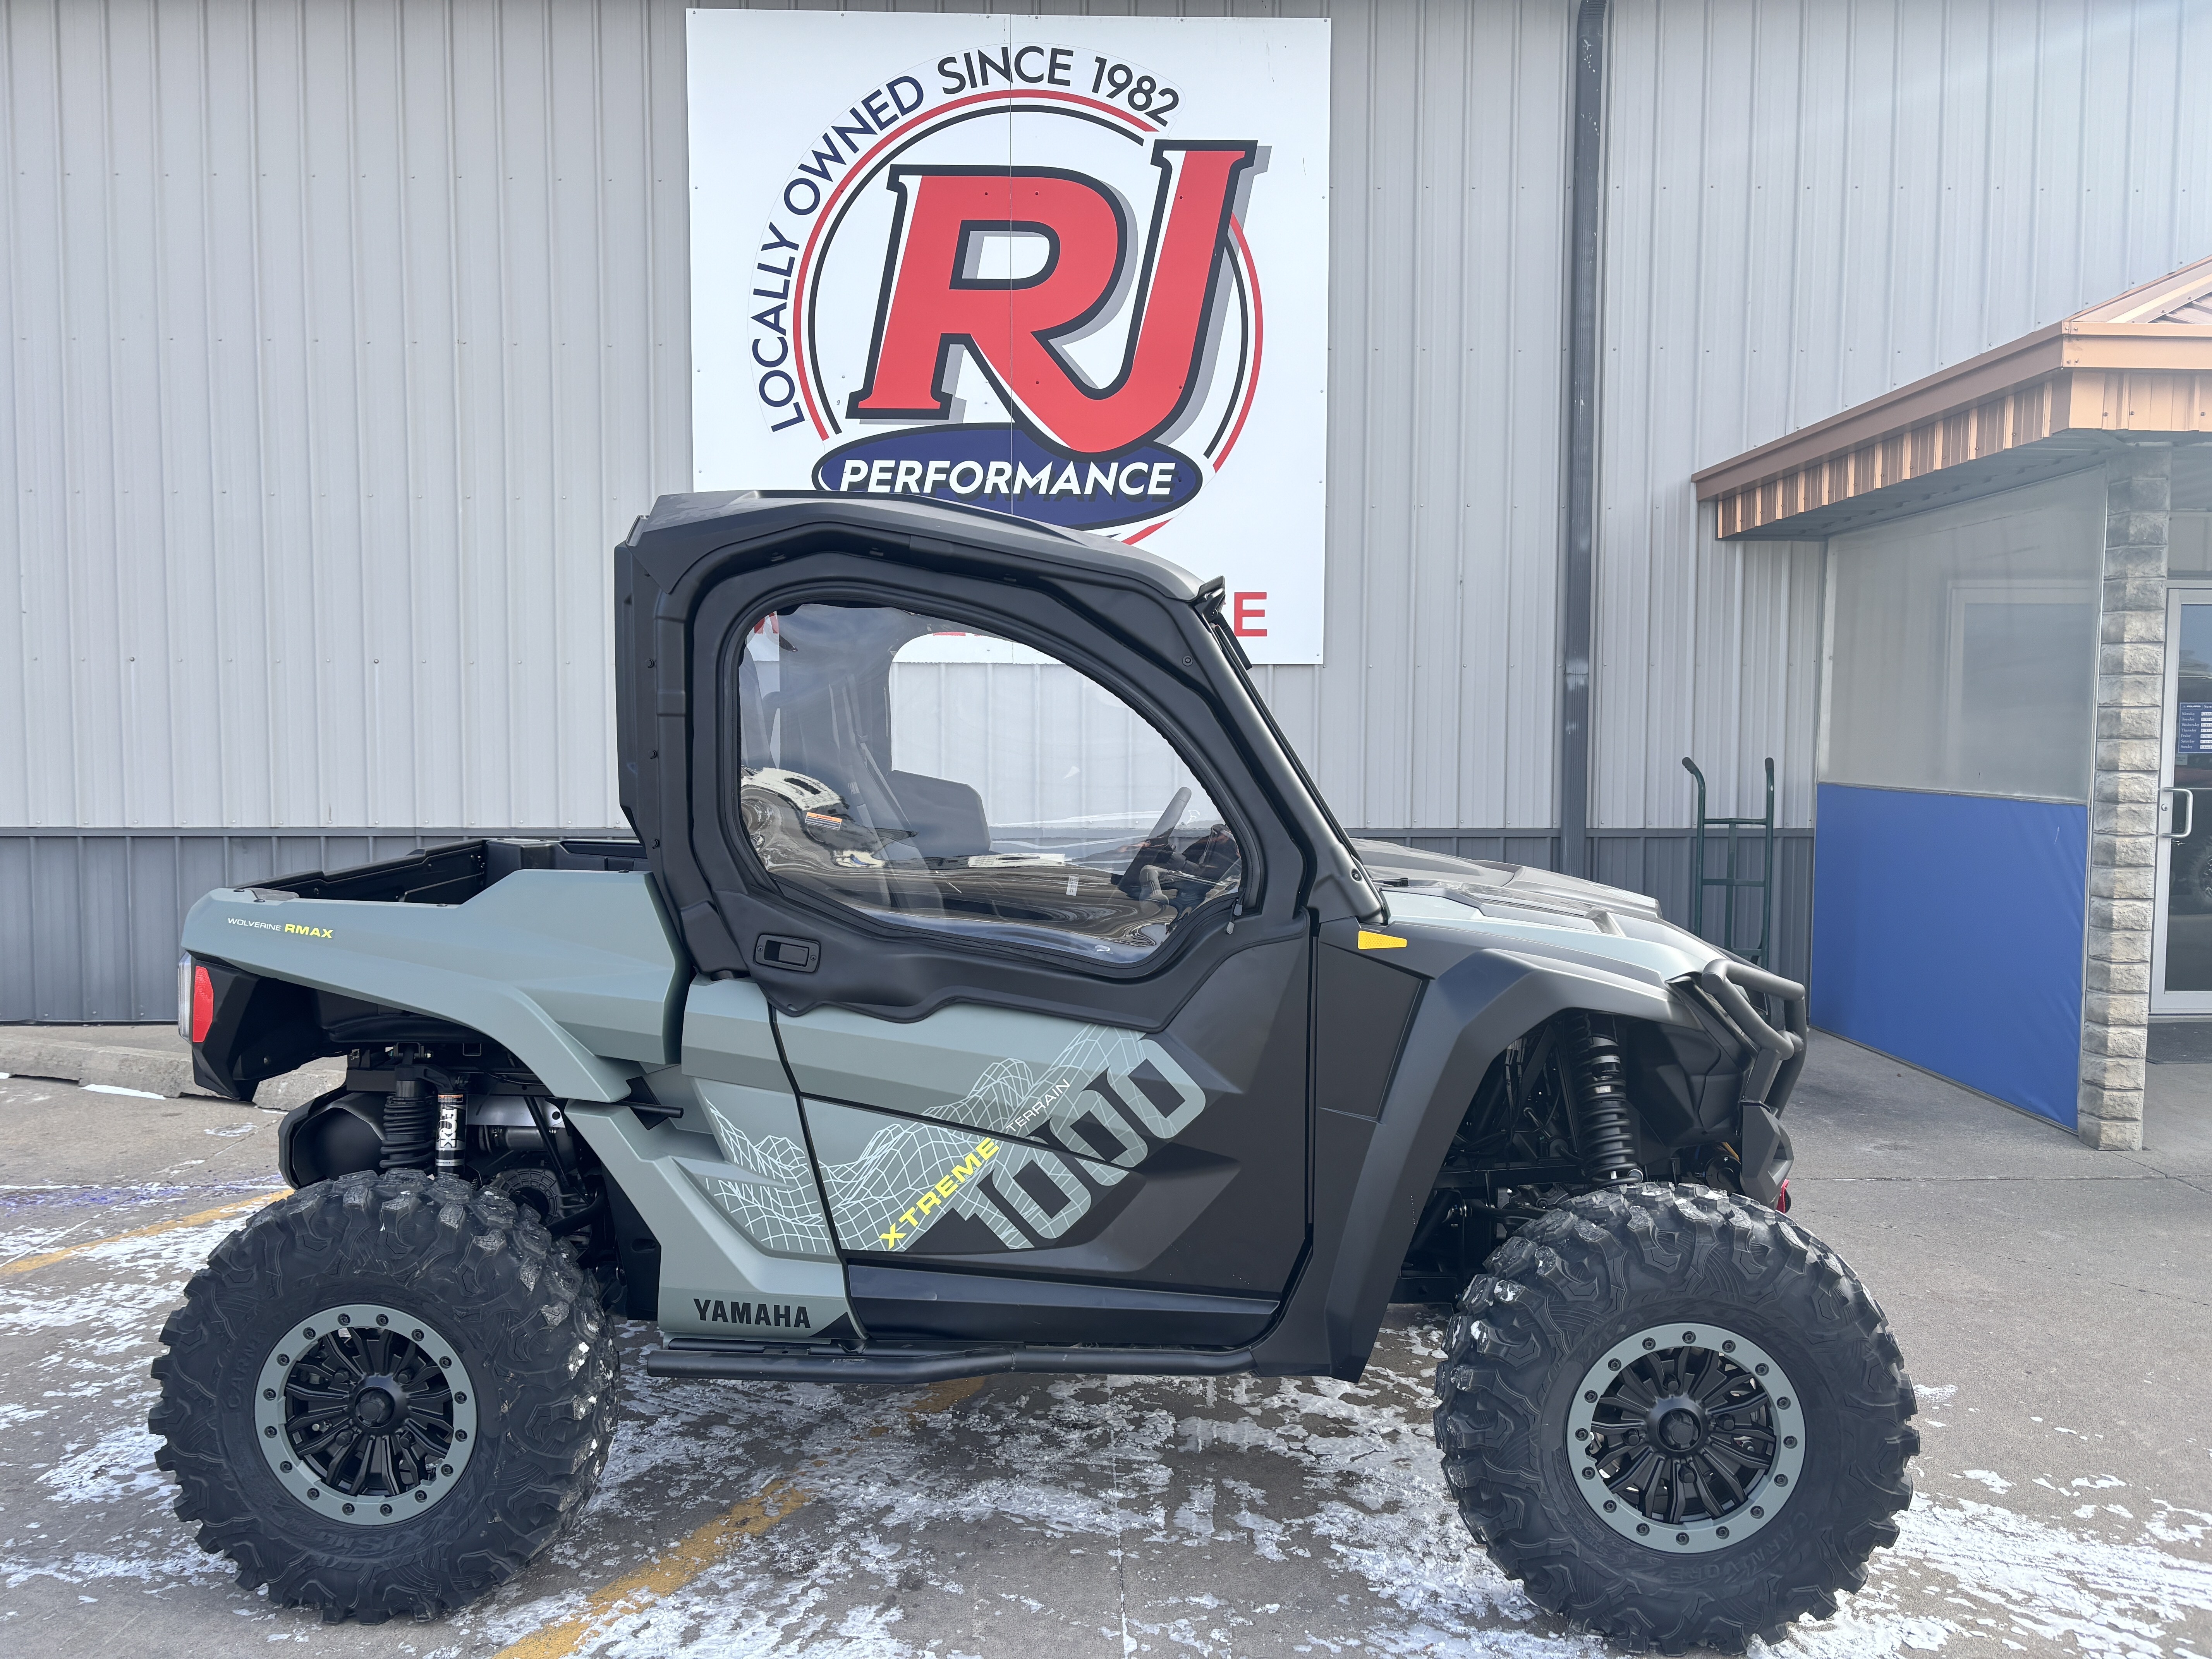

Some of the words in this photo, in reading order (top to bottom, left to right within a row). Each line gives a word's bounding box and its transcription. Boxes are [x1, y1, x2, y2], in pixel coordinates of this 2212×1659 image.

[751, 222, 806, 431] LOCALLY
[783, 76, 924, 215] OWNED
[937, 46, 1074, 94] SINCE
[1092, 57, 1180, 126] 1982
[846, 140, 1259, 460] RJ
[840, 461, 1176, 496] PERFORMANCE
[228, 917, 282, 932] WOLVERINE
[284, 923, 334, 939] RMAX
[437, 1108, 458, 1147] FOX
[964, 1039, 1206, 1249] 1000
[879, 1137, 1000, 1250] XTREME
[1006, 1078, 1072, 1133] TERRAIN
[693, 1298, 811, 1329] YAMAHA
[1670, 1511, 1809, 1580] CARNIVORE
